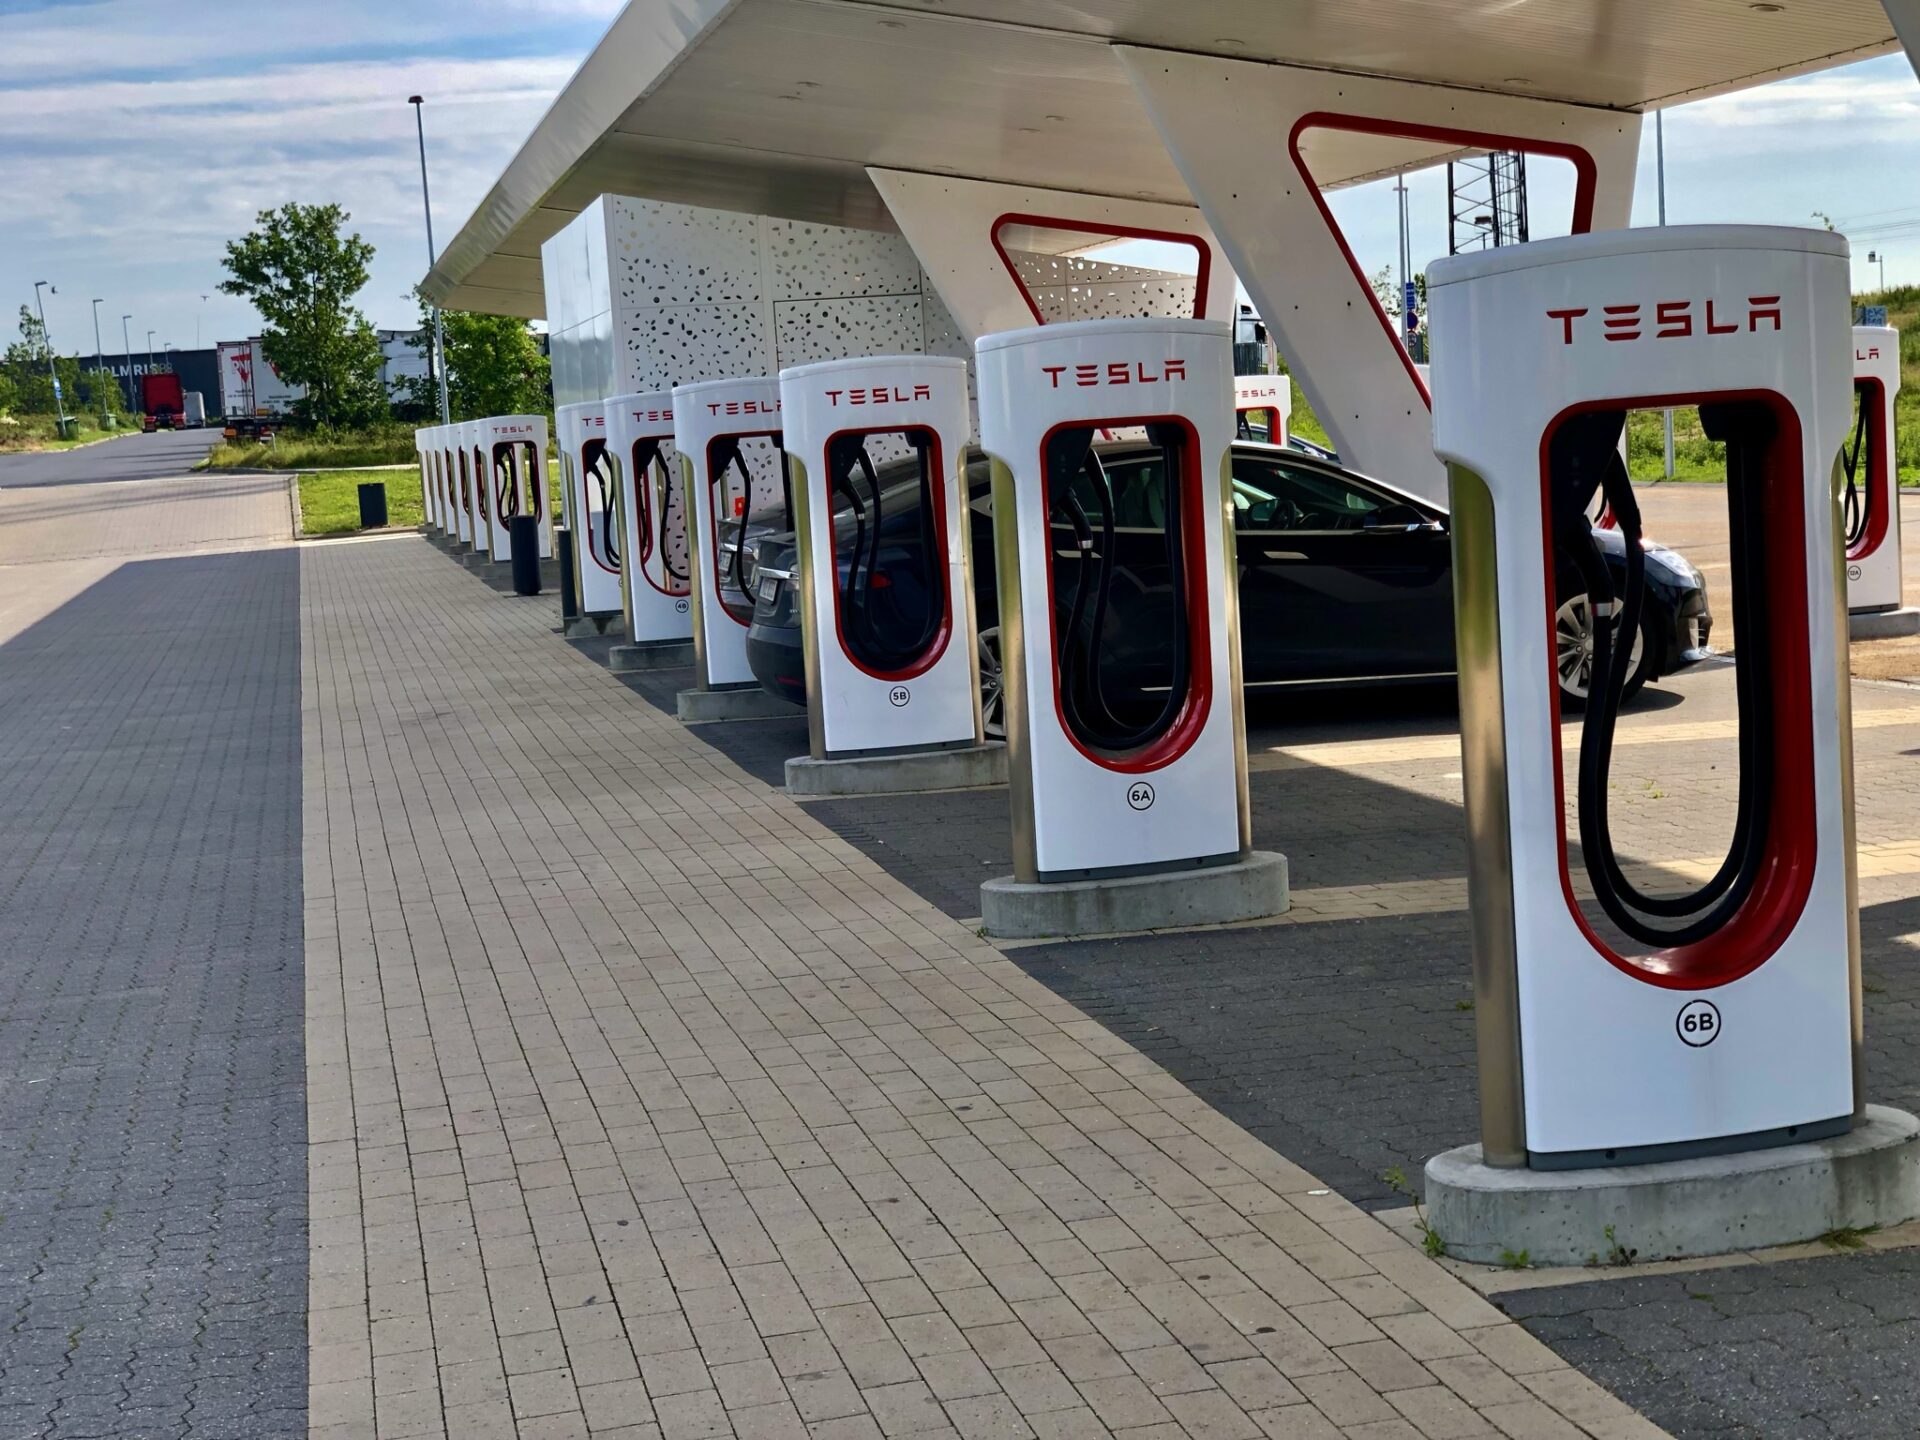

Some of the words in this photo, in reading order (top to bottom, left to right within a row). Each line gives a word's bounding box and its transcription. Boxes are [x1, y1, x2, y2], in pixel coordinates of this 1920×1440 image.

[1546, 296, 1781, 344] TESLA
[1042, 359, 1185, 388] TESLA
[825, 385, 930, 406] TESLA
[1235, 388, 1276, 398] ESLA
[632, 410, 673, 422] TES
[493, 424, 533, 433] TESLA
[893, 691, 907, 701] 5B
[1131, 790, 1151, 802] 6A
[1684, 1012, 1714, 1032] 6B
